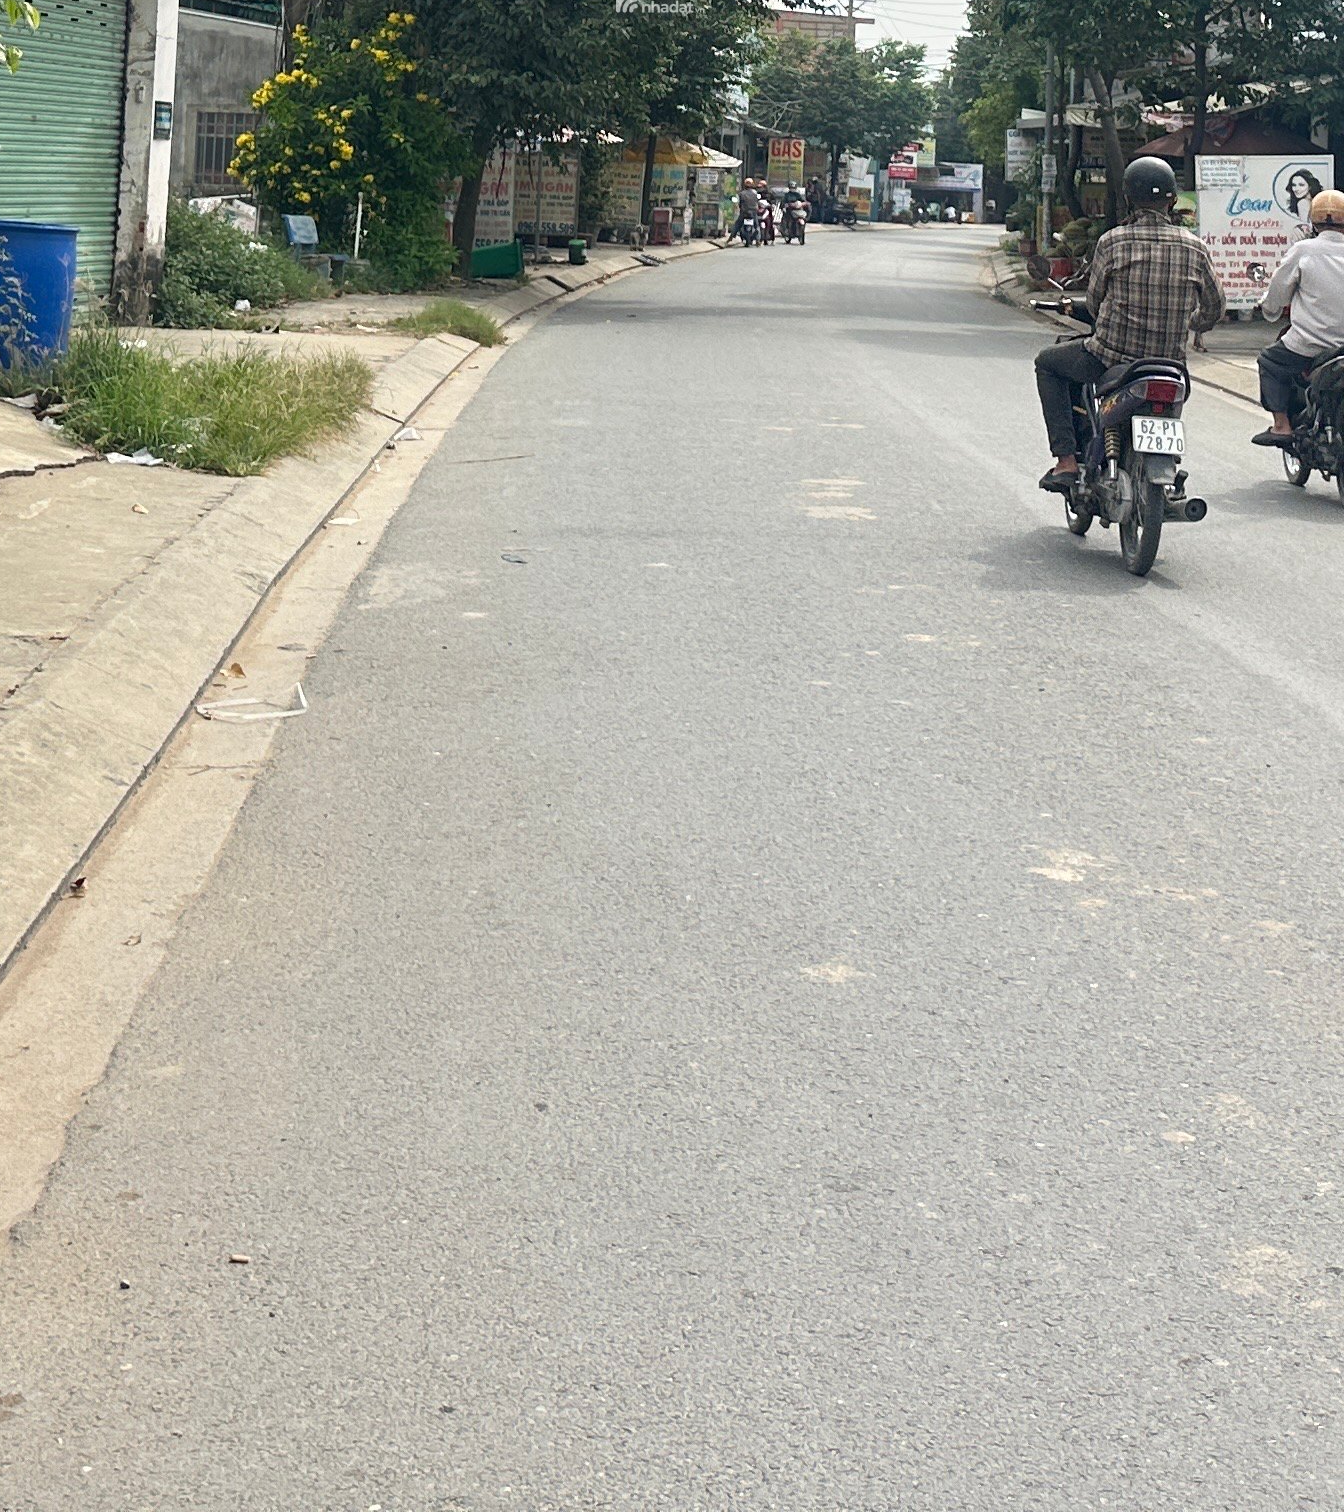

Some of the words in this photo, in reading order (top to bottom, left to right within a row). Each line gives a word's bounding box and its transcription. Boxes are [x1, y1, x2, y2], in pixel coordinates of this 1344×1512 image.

[772, 140, 802, 158] GAS
[1141, 420, 1176, 436] 62-P1
[1137, 435, 1183, 452] 728.70
